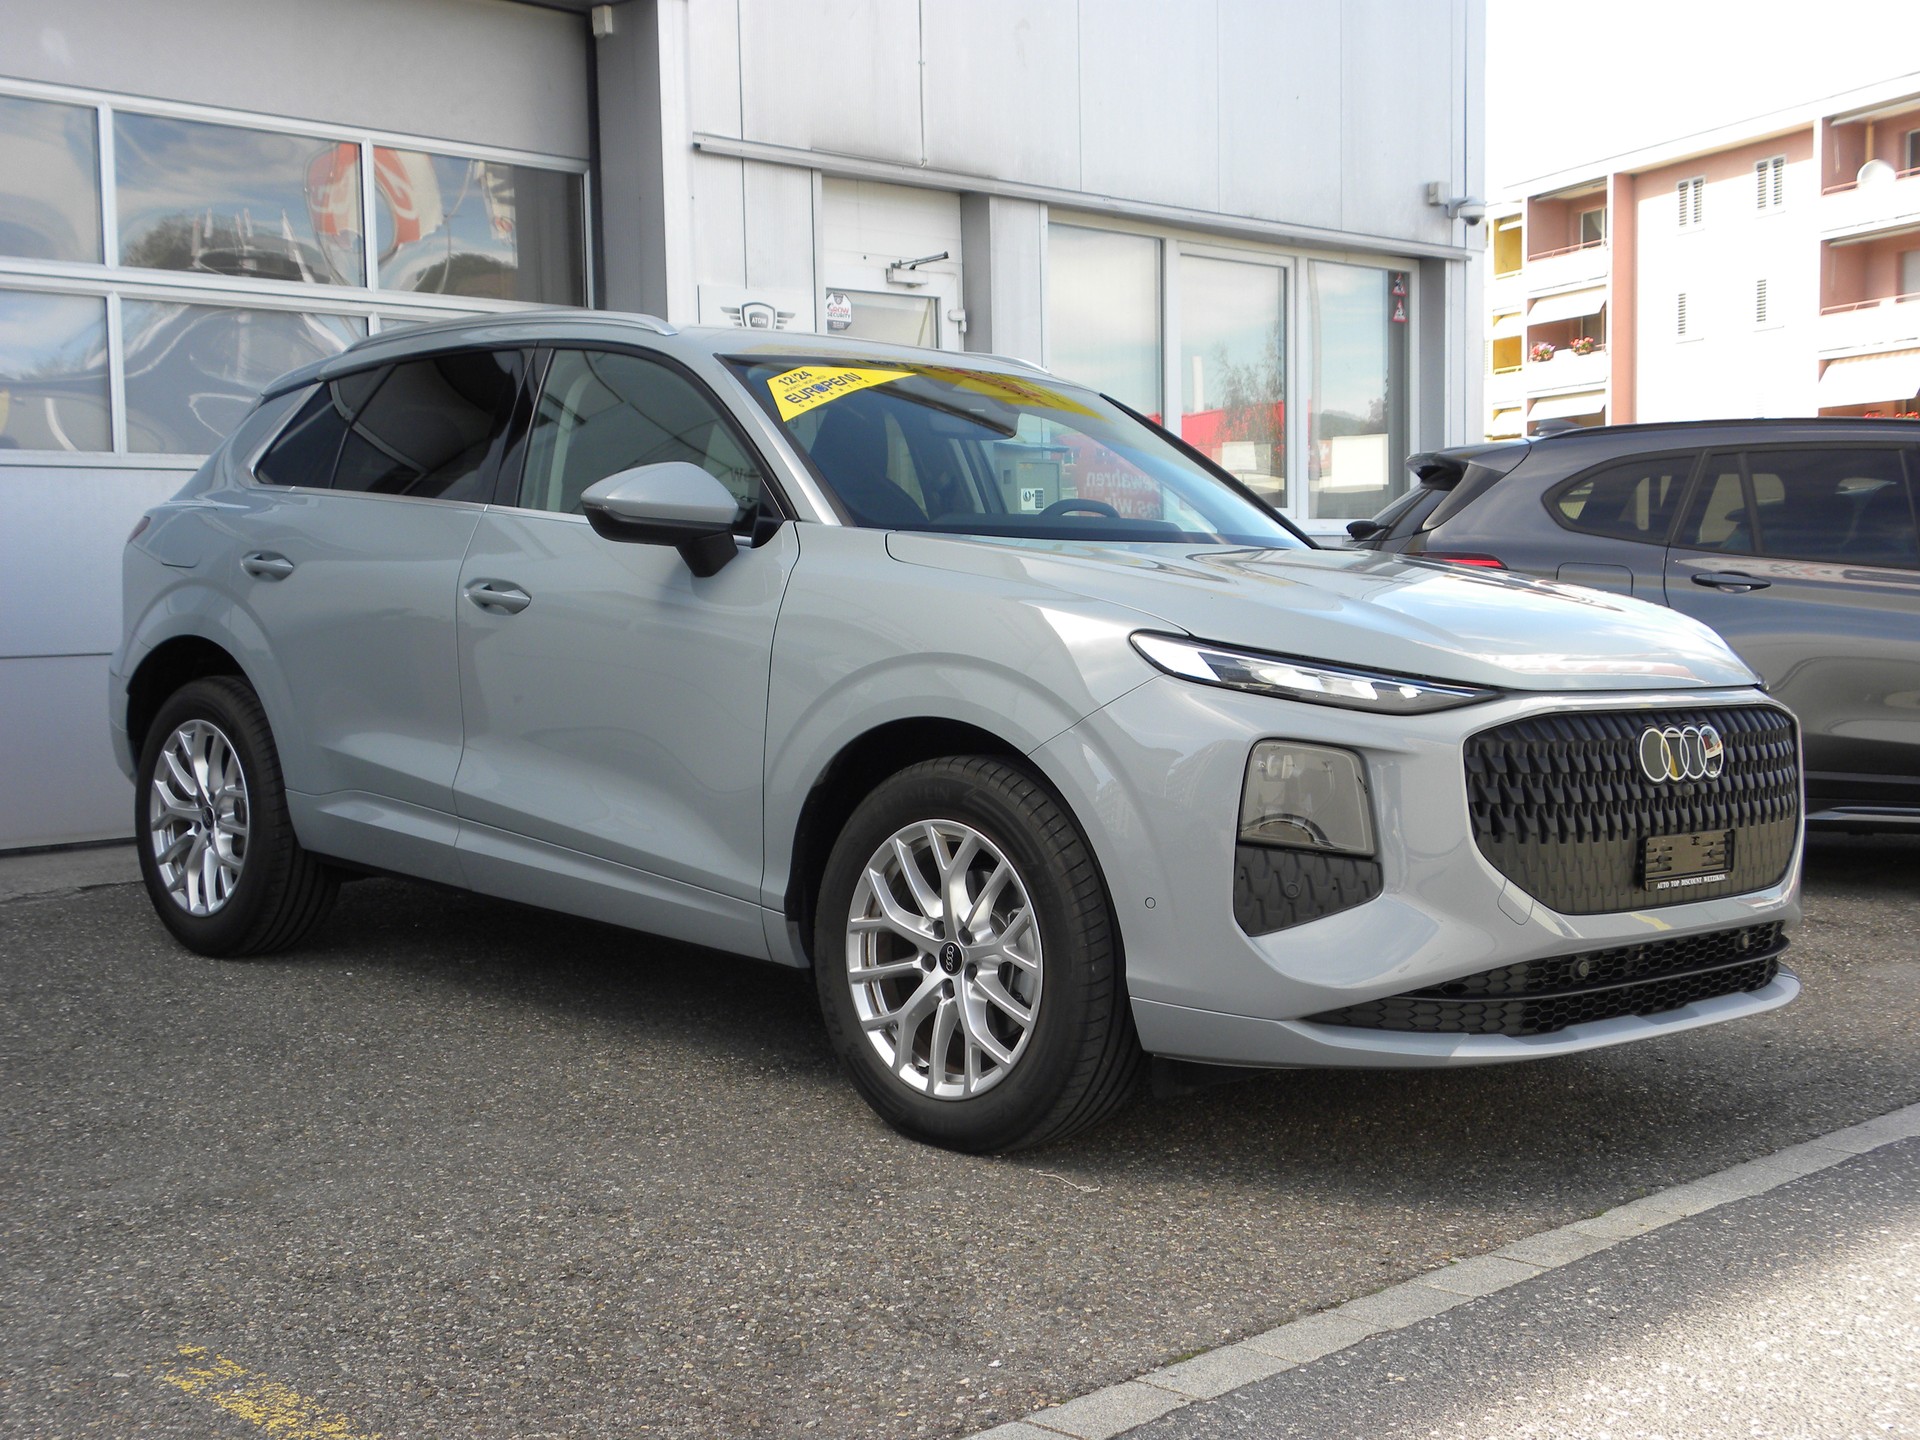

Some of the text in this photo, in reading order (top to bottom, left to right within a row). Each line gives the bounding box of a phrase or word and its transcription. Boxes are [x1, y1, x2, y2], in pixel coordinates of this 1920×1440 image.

[778, 370, 812, 386] 12/24
[1657, 882, 1670, 890] AUTO
[1671, 880, 1680, 888] TOP
[1681, 877, 1702, 886] DISCOUNT
